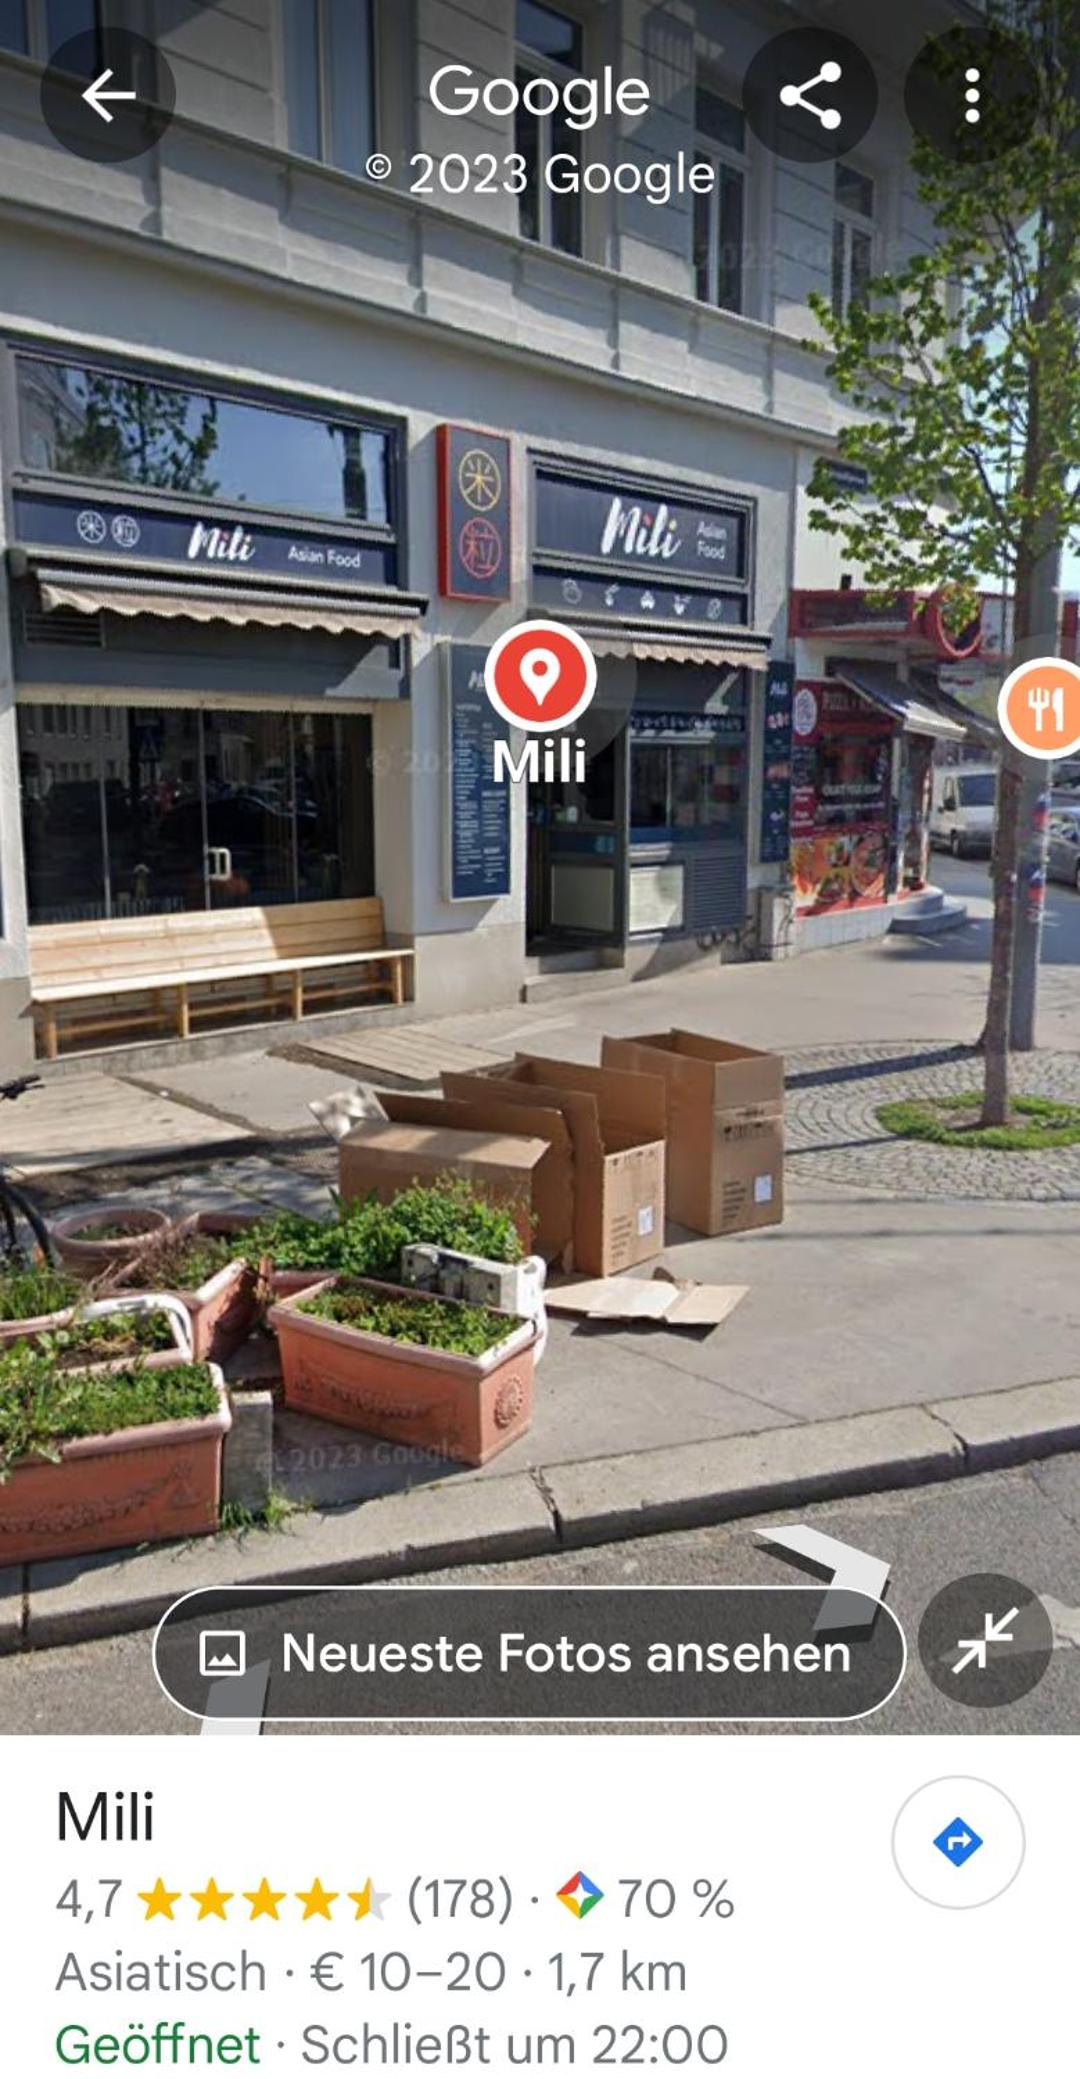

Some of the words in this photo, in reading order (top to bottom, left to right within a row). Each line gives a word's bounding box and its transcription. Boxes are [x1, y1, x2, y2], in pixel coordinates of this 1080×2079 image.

[601, 497, 682, 558] Mili
[697, 520, 728, 540] Asian
[188, 521, 255, 561] Mili
[288, 545, 324, 564] Asian
[327, 549, 361, 568] Food
[697, 540, 726, 560] Food
